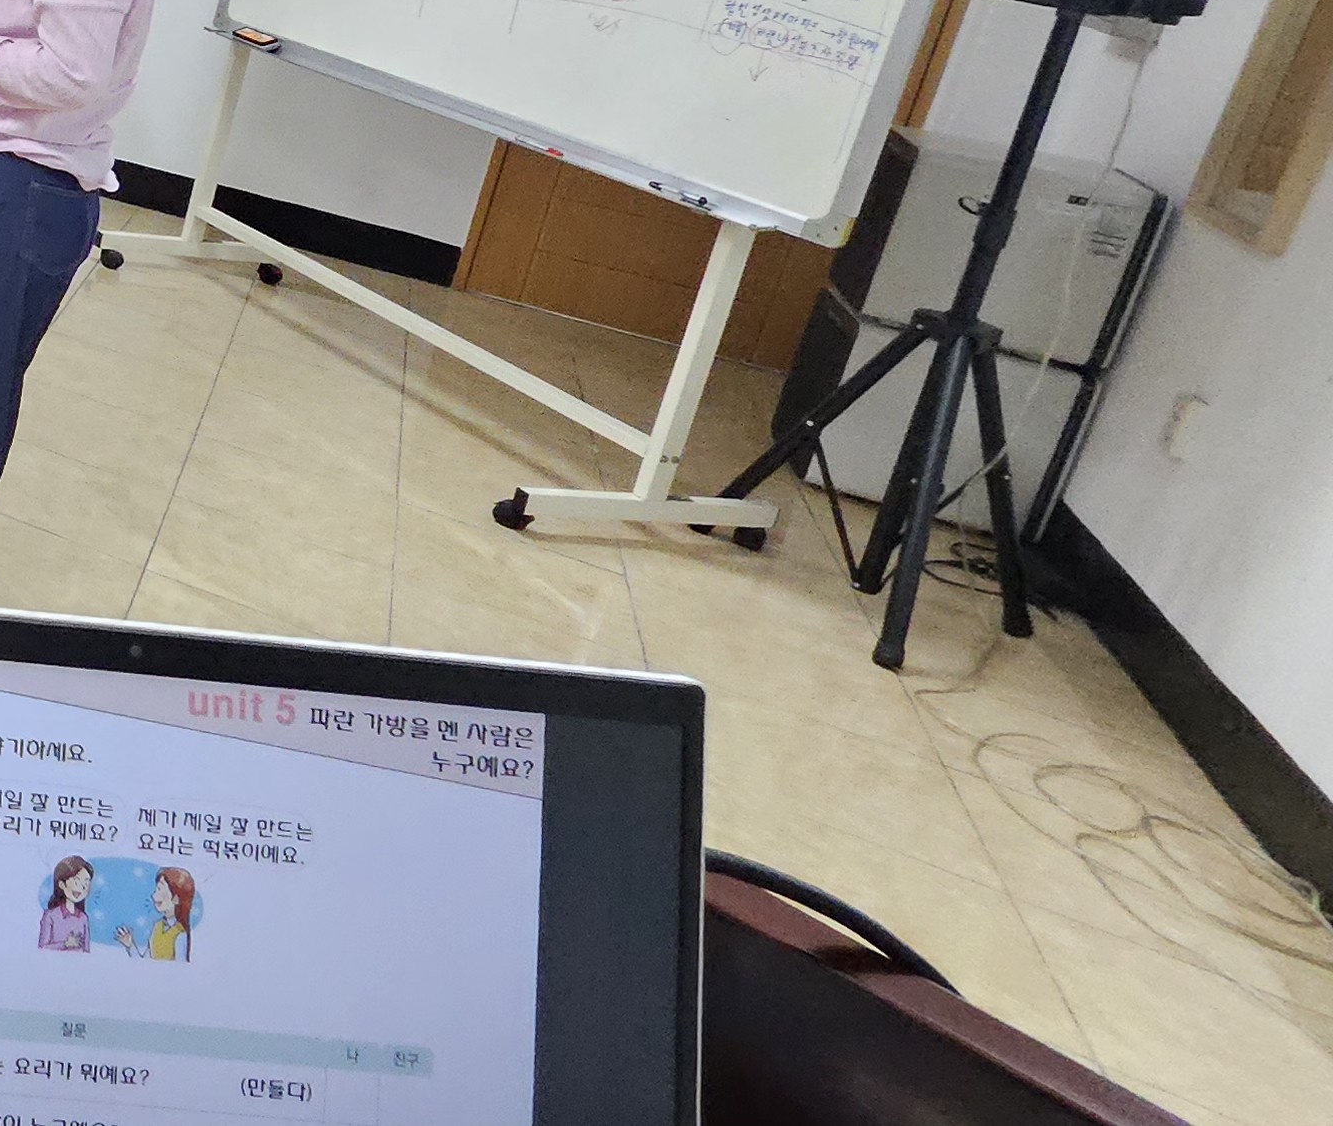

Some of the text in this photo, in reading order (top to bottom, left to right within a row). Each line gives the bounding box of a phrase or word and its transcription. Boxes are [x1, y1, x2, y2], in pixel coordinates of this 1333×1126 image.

[188, 689, 264, 723] unit
[276, 694, 296, 725] 5
[310, 707, 355, 733] 파란
[362, 712, 430, 741] 가방을
[467, 723, 534, 750] 사람은
[30, 792, 50, 812] 잘
[57, 795, 114, 819] 만드는
[138, 807, 313, 843] 제가 제일 잘 만드는
[137, 832, 194, 857] 요리는
[346, 1046, 359, 1064] 나
[393, 1051, 421, 1068] 친구
[15, 1058, 73, 1081] 요리가
[240, 1077, 313, 1103] (만들다)
